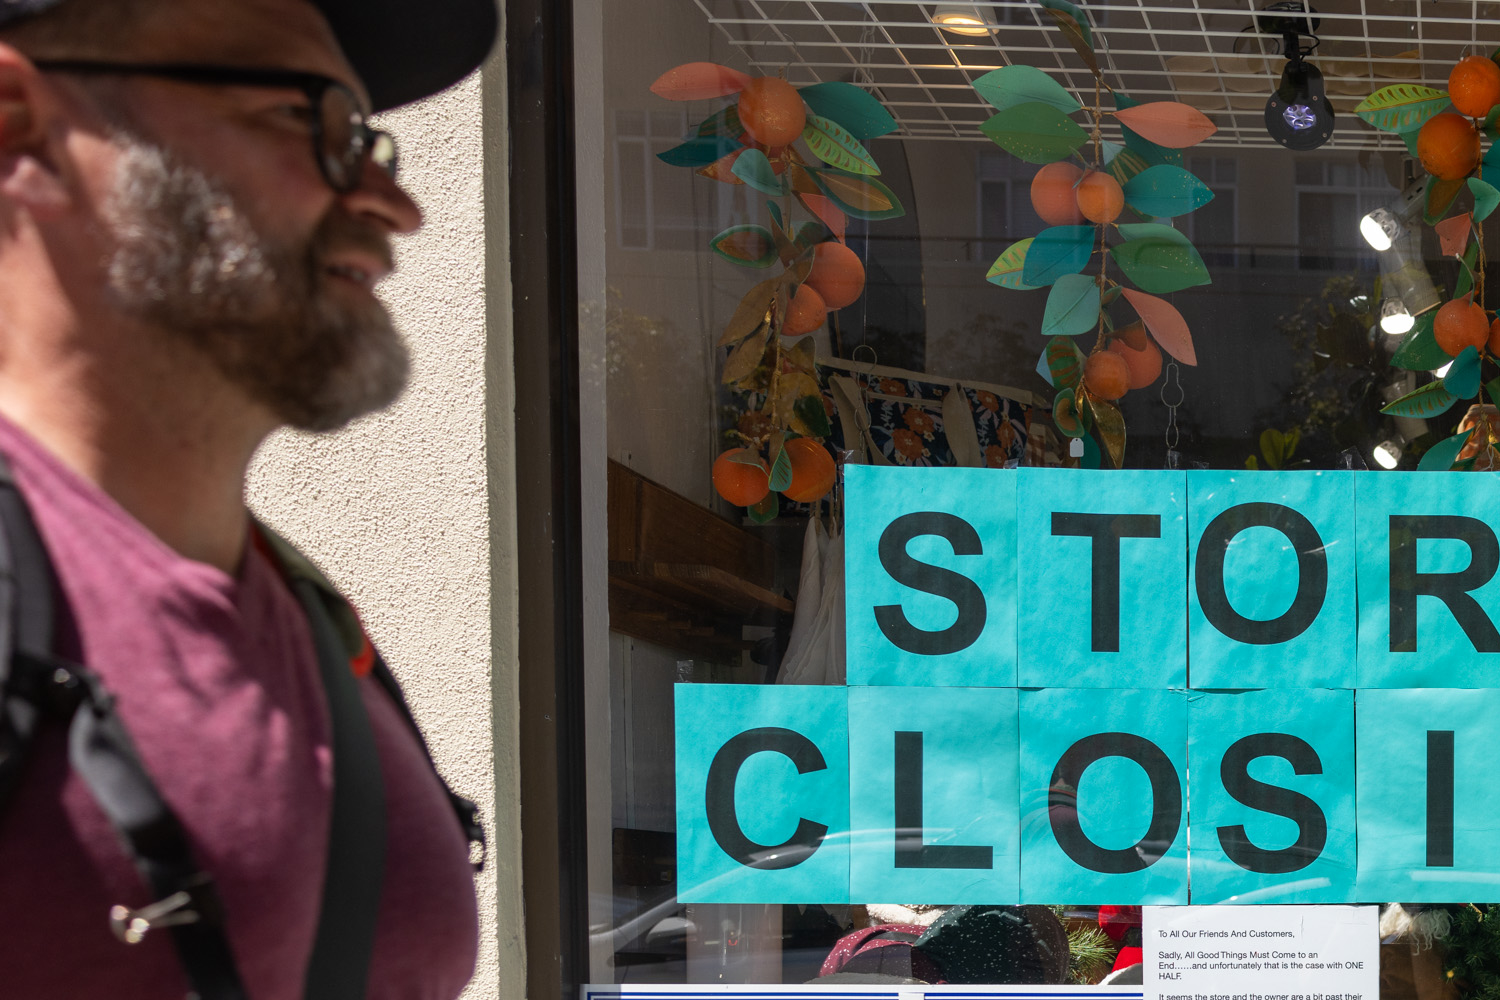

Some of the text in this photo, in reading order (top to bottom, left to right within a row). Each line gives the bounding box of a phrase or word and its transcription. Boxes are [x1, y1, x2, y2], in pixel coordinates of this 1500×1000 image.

[1159, 930, 1167, 938] To
[1182, 930, 1196, 938] Our
[1200, 930, 1228, 938] Friends
[1249, 930, 1294, 938] Customers,
[1158, 951, 1182, 960] Sadly,
[1197, 951, 1219, 959] Good
[1220, 951, 1247, 960] Things
[1158, 972, 1182, 980] HALF.
